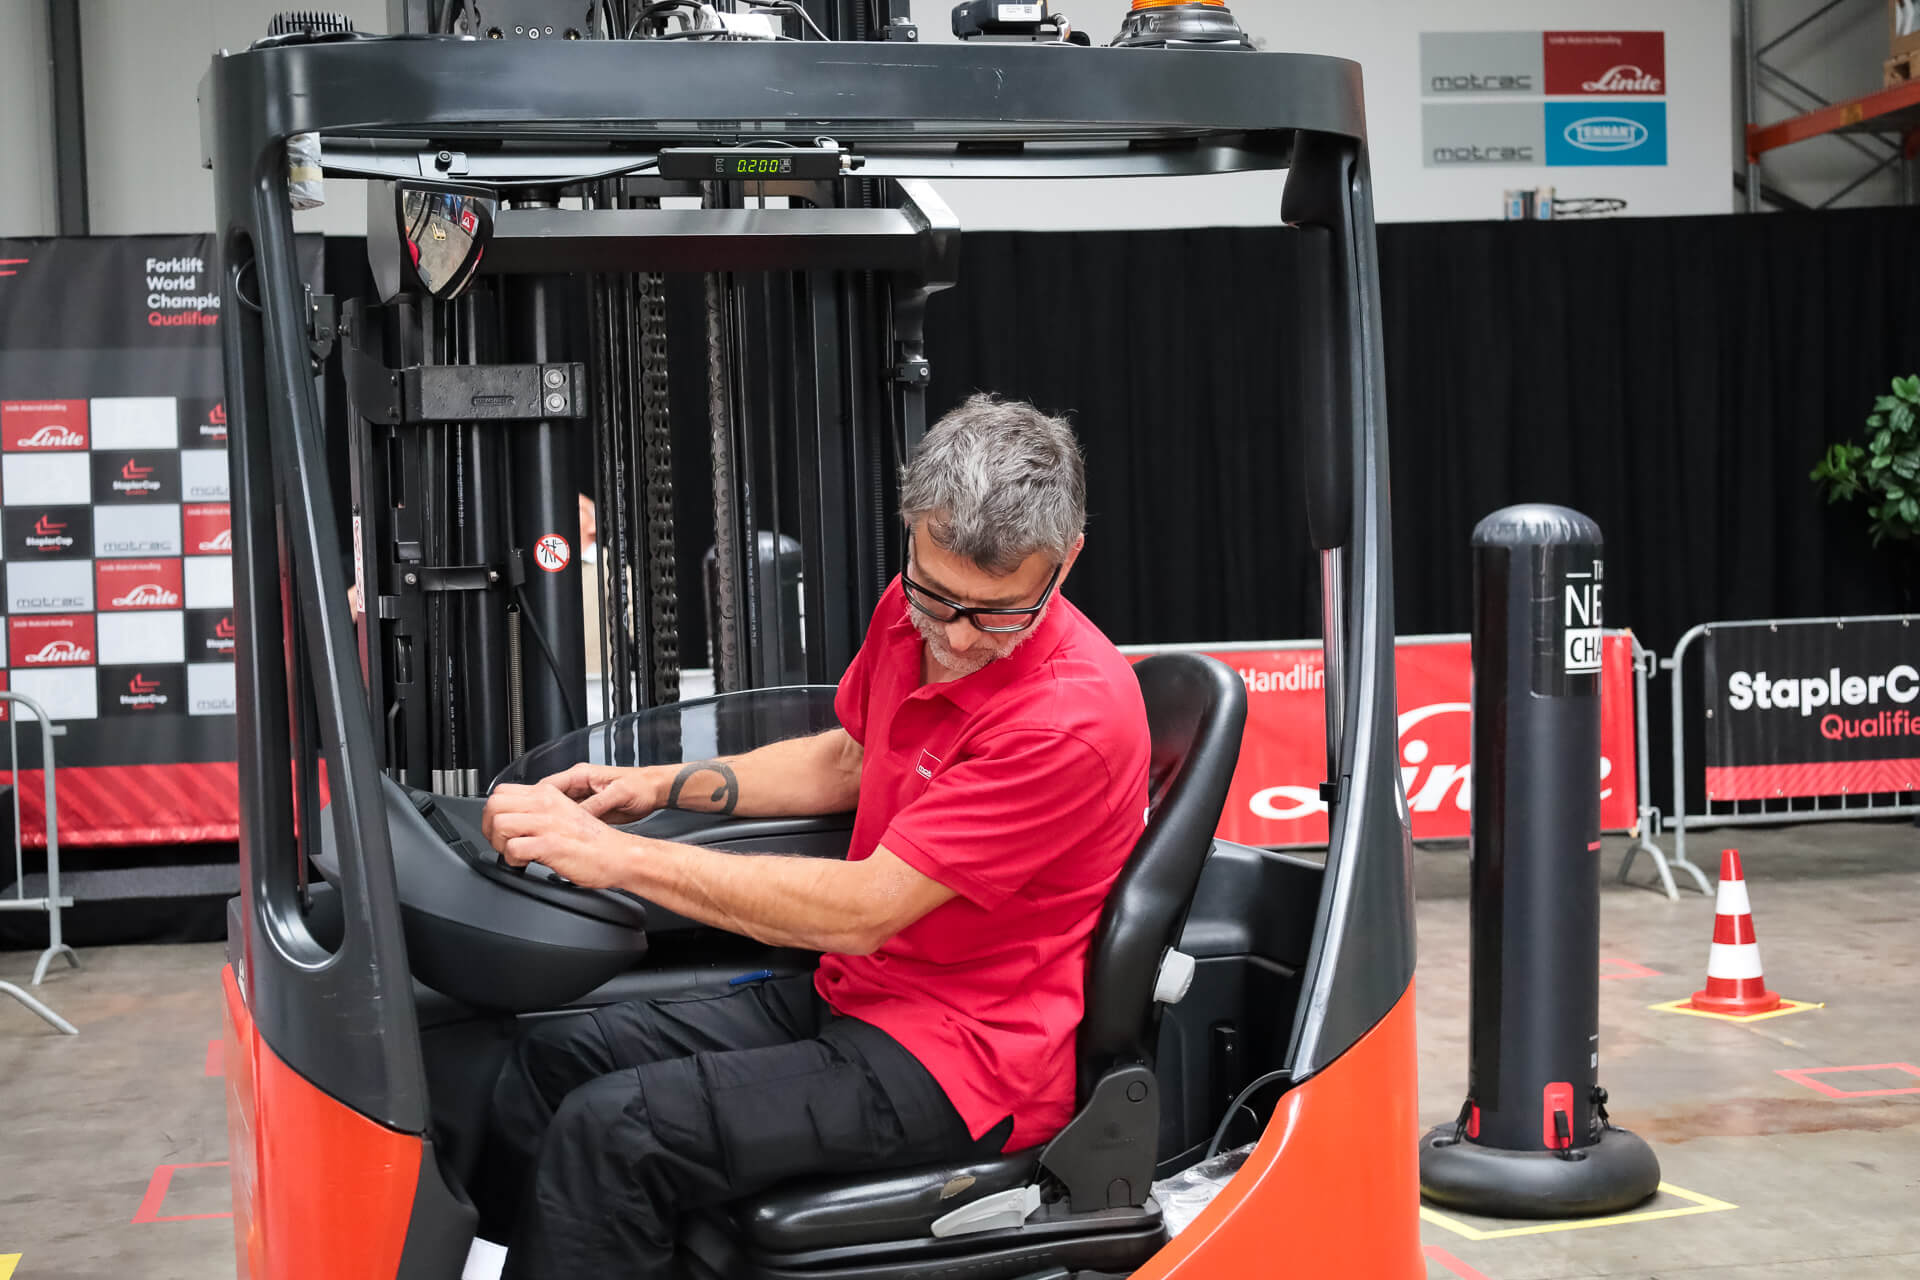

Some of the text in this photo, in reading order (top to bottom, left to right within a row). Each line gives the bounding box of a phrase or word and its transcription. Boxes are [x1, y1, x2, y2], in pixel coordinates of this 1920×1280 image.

[1432, 75, 1531, 92] motrac
[1582, 65, 1661, 91] Linde
[1433, 146, 1533, 162] motrac
[737, 159, 779, 173] 0.200
[146, 257, 204, 273] Forklift
[146, 275, 196, 291] World
[147, 292, 220, 311] Champio
[148, 311, 218, 327] Qualifier
[17, 425, 84, 447] Linde
[112, 584, 178, 606] Linde
[25, 641, 91, 663] Linde
[1240, 663, 1325, 693] Handlin
[1729, 665, 1920, 716] StaplerC
[1820, 710, 1920, 740] Qualifie
